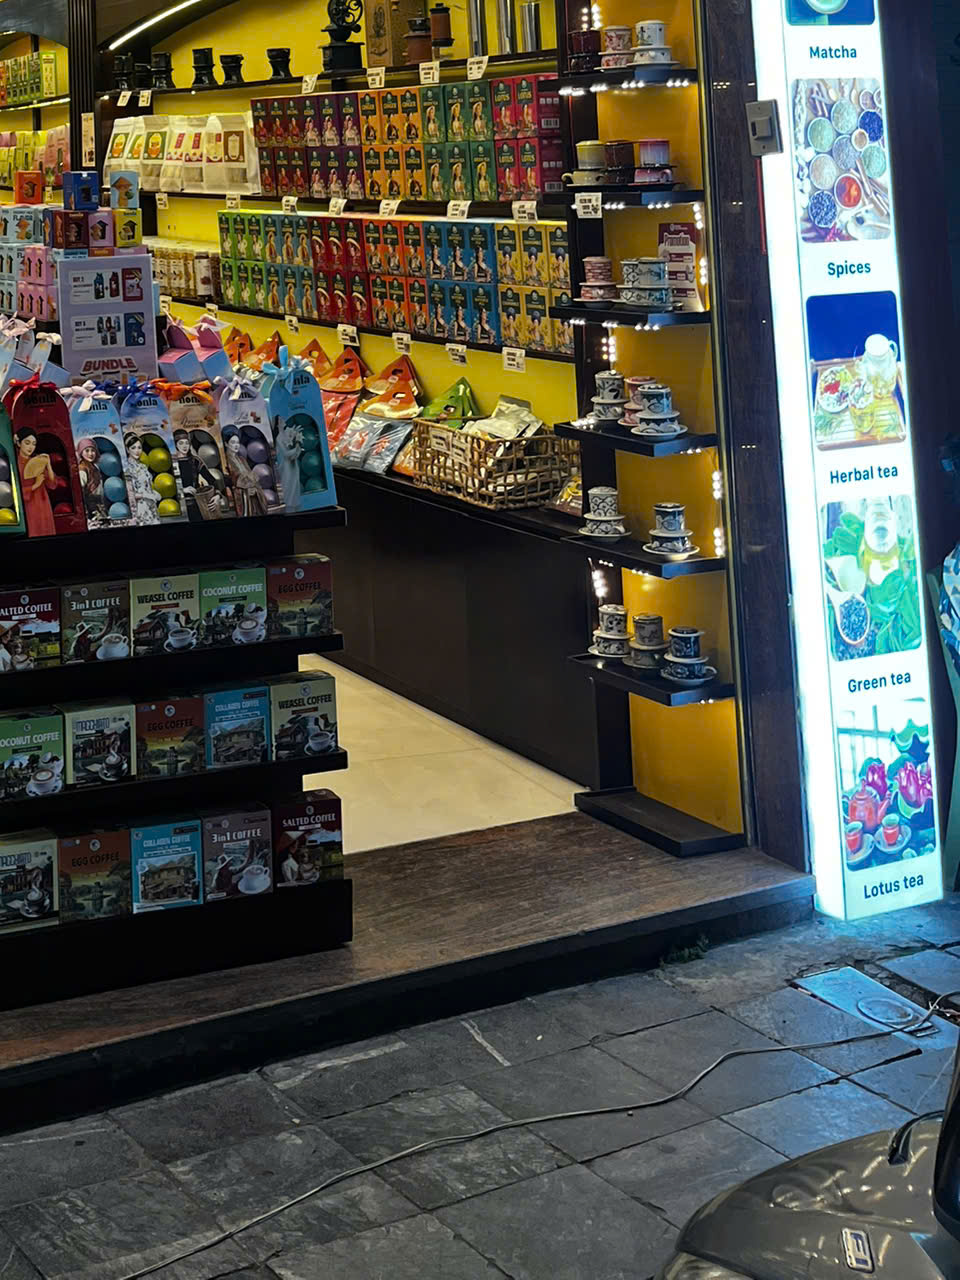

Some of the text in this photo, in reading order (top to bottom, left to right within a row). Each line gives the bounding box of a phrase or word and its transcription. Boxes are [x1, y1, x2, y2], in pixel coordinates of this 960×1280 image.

[808, 44, 858, 60] Matcha
[826, 260, 871, 277] Spices
[82, 357, 137, 372] BUNDLE
[829, 465, 899, 484] Herbal tea
[202, 583, 263, 597] COCONUT COFFEE
[278, 581, 321, 593] EGG COFFEE
[70, 597, 121, 611] 3in1 COFFEE
[137, 590, 194, 604] WEASEL COFFEE
[25, 603, 53, 614] COFFEE
[847, 670, 912, 694] Green tea
[278, 694, 332, 710] WEASEL COFFEE
[147, 718, 193, 732] EGG COFFEE
[32, 731, 60, 744] COFFEE
[282, 813, 337, 828] SALTED COFFEE
[211, 828, 262, 843] 3in1 COFFEE
[71, 851, 120, 867] EGG COFFEE
[863, 873, 924, 900] Lotus tea
